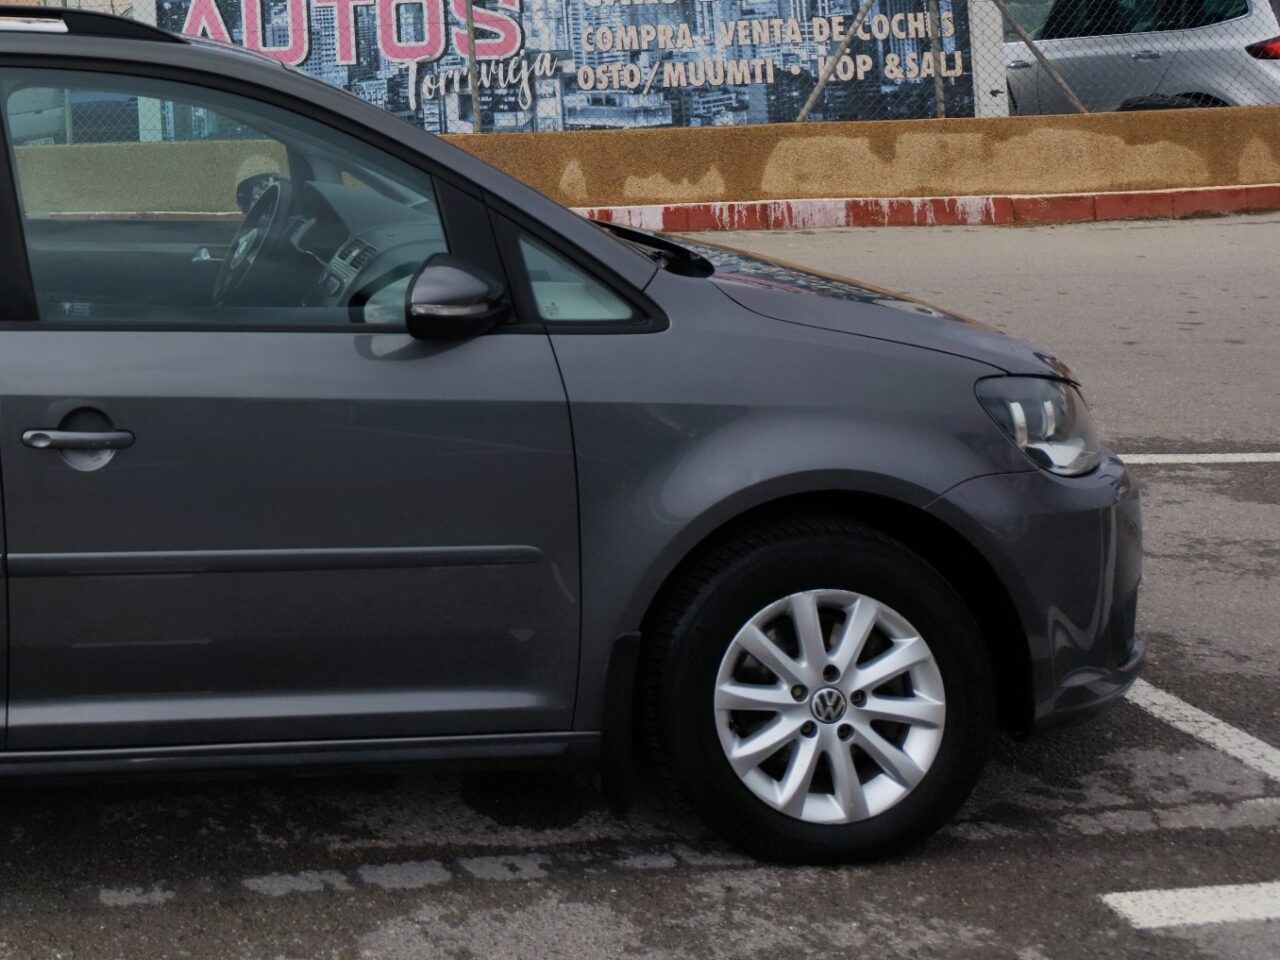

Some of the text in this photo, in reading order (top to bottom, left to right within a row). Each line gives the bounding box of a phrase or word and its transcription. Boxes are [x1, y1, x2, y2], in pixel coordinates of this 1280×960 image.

[581, 22, 695, 52] COMPRA
[719, 17, 803, 47] VENTA
[812, 15, 848, 42] DE
[577, 58, 775, 96] OSTO/MUUMTI
